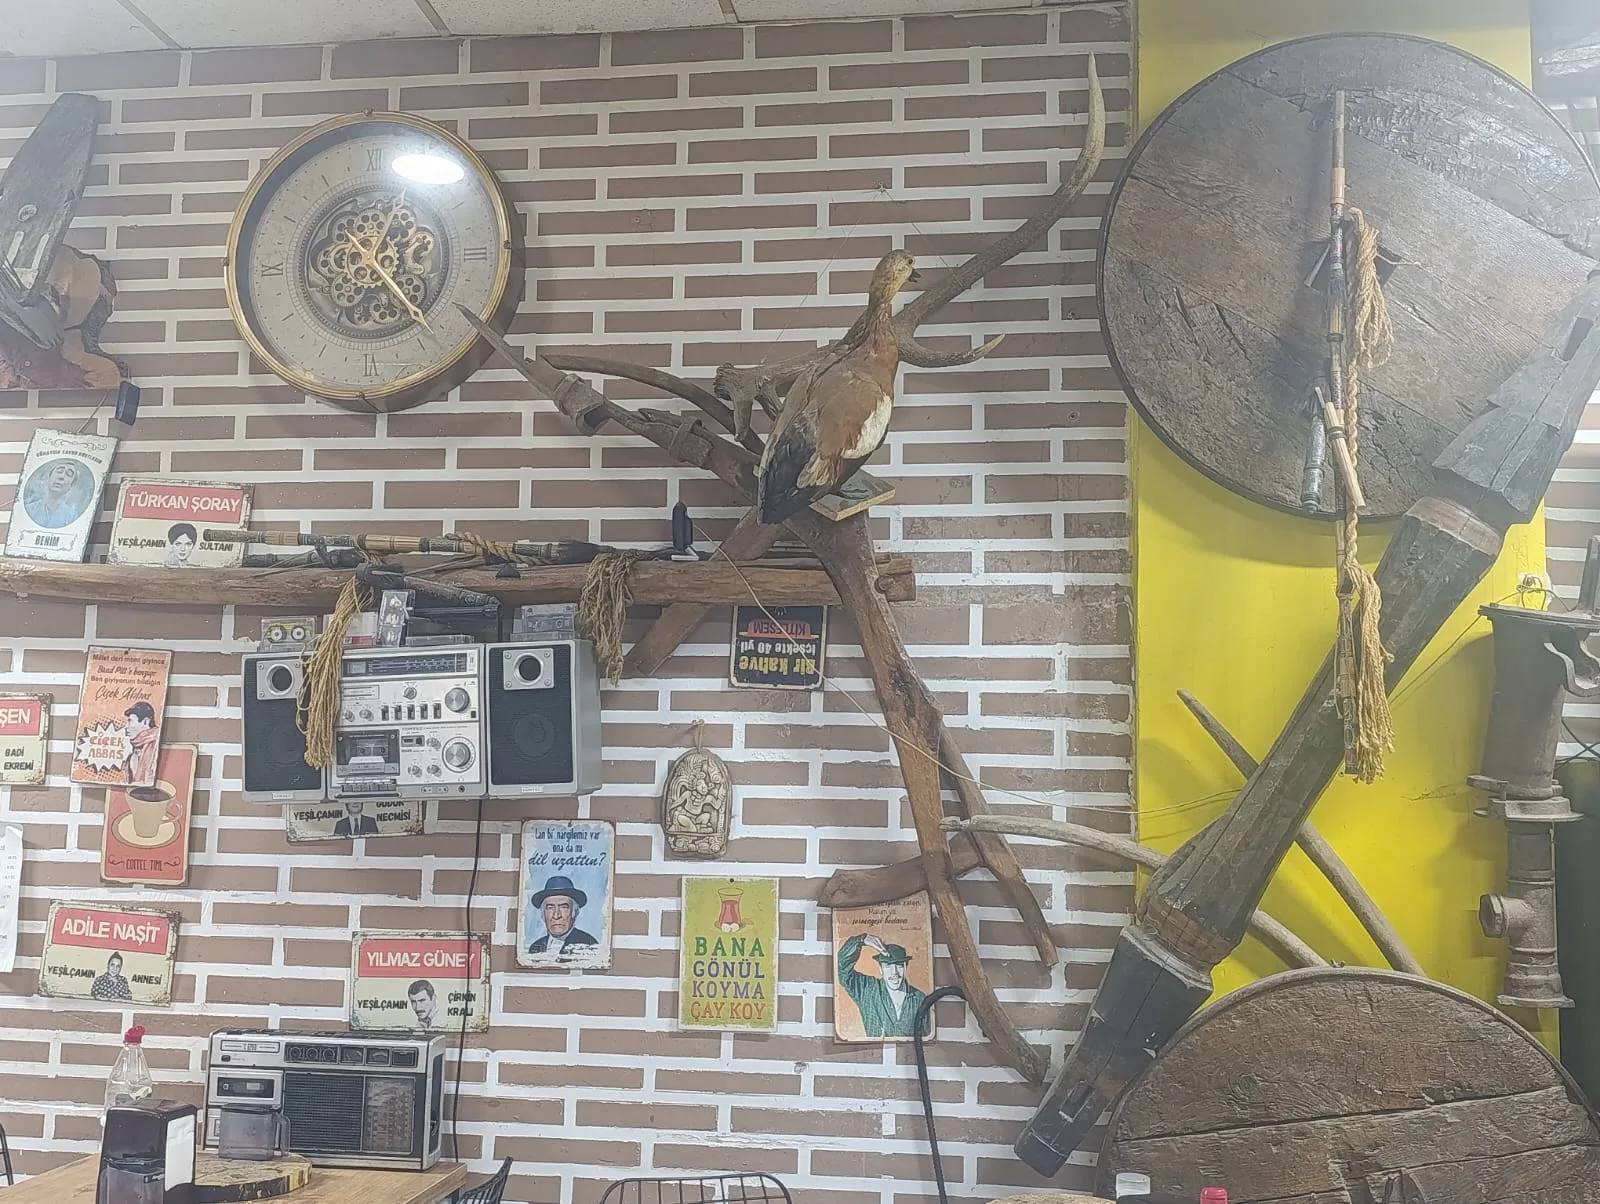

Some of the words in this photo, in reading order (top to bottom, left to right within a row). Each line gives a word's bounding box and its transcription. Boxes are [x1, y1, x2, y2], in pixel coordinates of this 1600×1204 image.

[130, 491, 188, 509] TÜRKAN
[191, 497, 240, 512] ŞORAY
[35, 534, 60, 546] BENİM
[118, 536, 167, 548] YEŞİLÇAMIN
[199, 542, 234, 552] SULTANI
[758, 642, 772, 654] 40
[739, 656, 788, 675] kahve
[793, 658, 816, 675] Bir
[0, 708, 31, 728] ŞEN
[5, 746, 24, 757] BADİ
[88, 748, 124, 760] ABBAS
[4, 760, 34, 770] EKREMİ
[294, 809, 343, 822] YEŞİLÇAMIN
[376, 809, 411, 822] NECMİSİ
[535, 828, 546, 840] Lan
[556, 828, 588, 842] nargilemiz
[590, 831, 600, 840] var
[552, 844, 564, 852] ona
[566, 842, 573, 852] da
[528, 851, 548, 866] dil
[61, 916, 110, 938] ADİLE
[113, 922, 160, 946] NAŞİT
[694, 936, 765, 957] BANA
[367, 951, 420, 967] YILMAZ
[424, 950, 476, 968] GÜNEY
[48, 964, 96, 979] YEŞİLÇAMIN
[693, 958, 765, 978] GÖNÜL
[132, 974, 162, 985] ANNESİ
[448, 990, 476, 1004] ÇİRKİN
[692, 980, 765, 1000] KOYMA
[358, 998, 408, 1012] YEŞİLÇAMIN
[448, 1007, 474, 1016] KRALI
[690, 1001, 725, 1022] ÇAY
[730, 1002, 766, 1020] KOY
